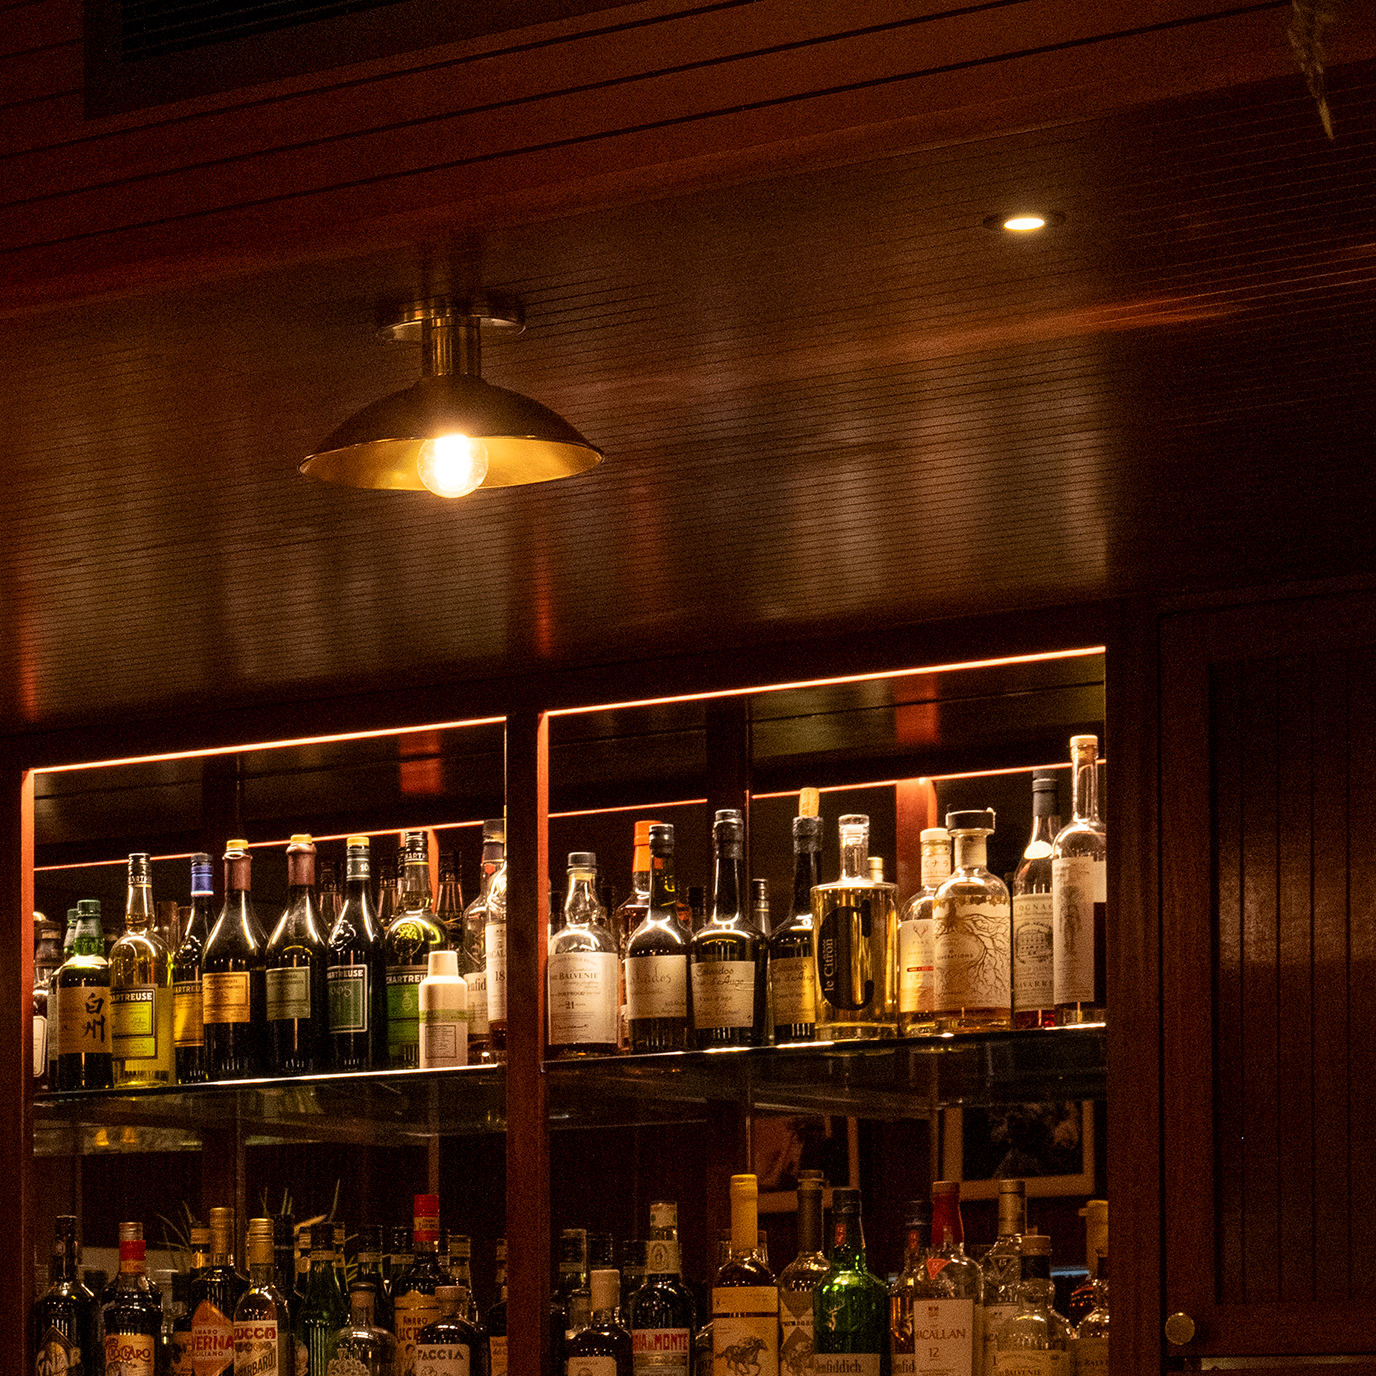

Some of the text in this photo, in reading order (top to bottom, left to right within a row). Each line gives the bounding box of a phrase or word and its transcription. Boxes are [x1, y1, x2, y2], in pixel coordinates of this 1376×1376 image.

[824, 938, 834, 981] Citron
[559, 972, 598, 980] BALVENIE
[565, 1001, 575, 1010] 21
[654, 1333, 689, 1350] MONTE
[929, 1347, 940, 1358] 12
